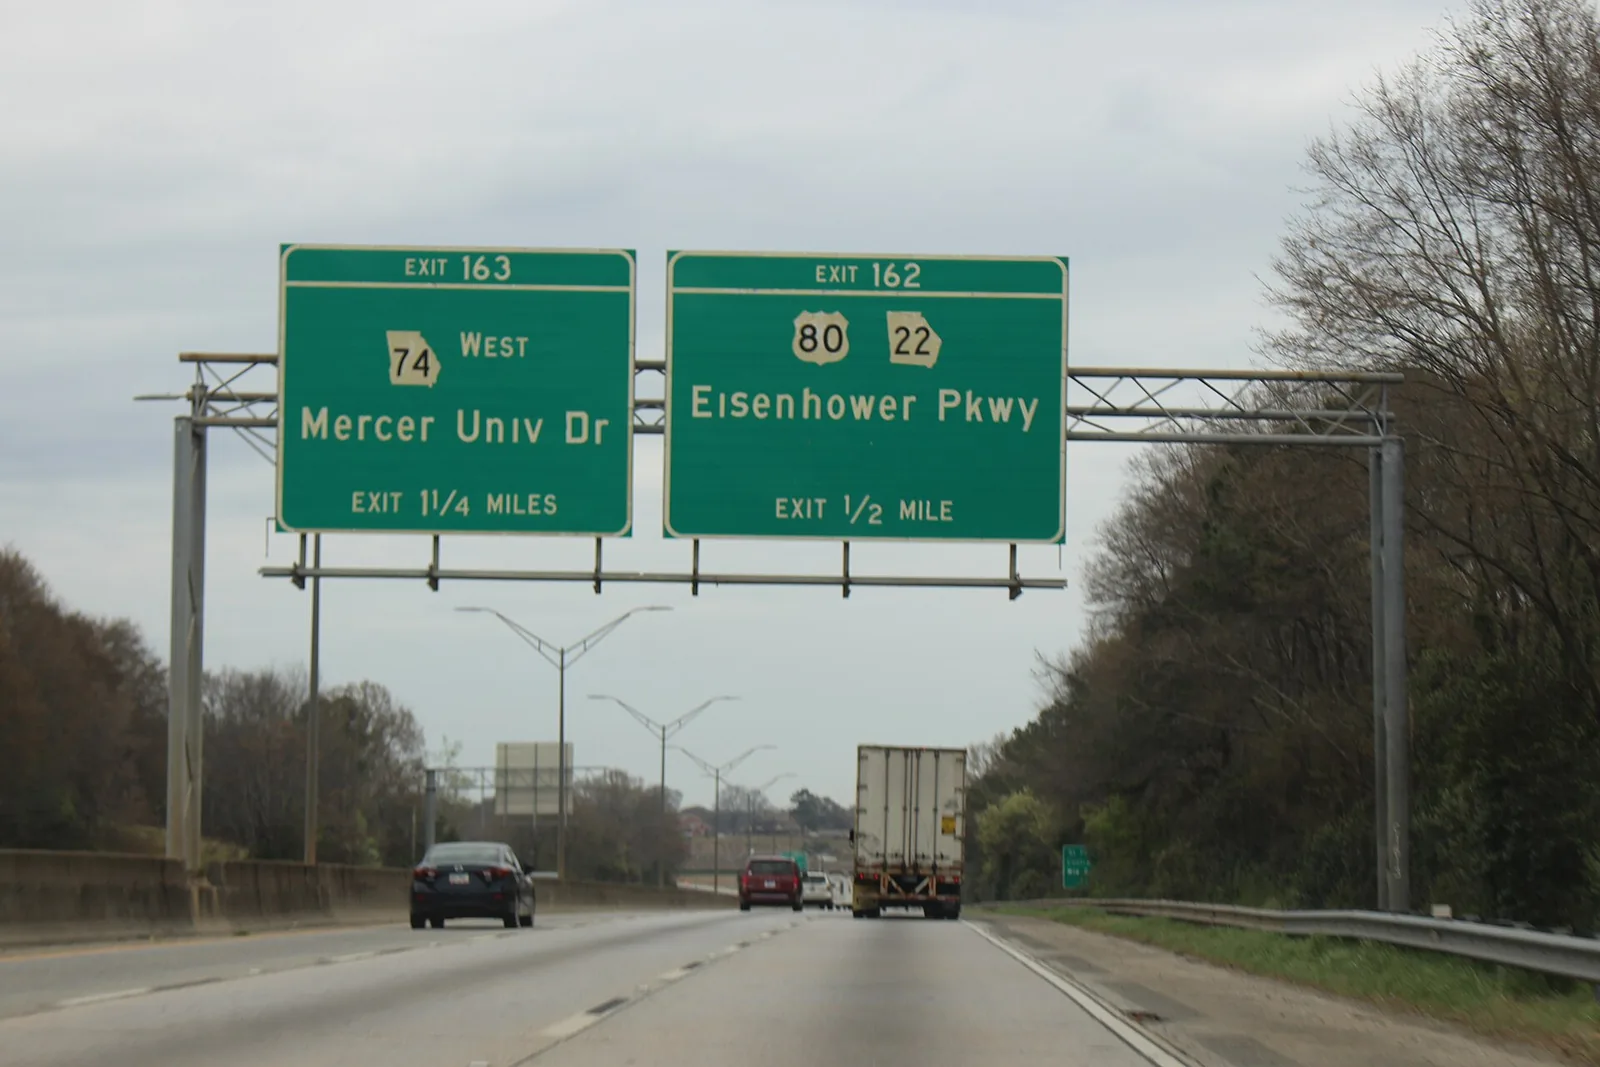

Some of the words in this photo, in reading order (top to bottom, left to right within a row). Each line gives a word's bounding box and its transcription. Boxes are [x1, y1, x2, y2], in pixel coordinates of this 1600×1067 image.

[406, 259, 447, 275] EXIT
[463, 256, 510, 280] 163
[816, 266, 857, 282] EXIT
[873, 263, 920, 287] 162
[799, 325, 843, 353] 80
[894, 327, 930, 355] 22
[394, 349, 430, 377] 74
[692, 386, 916, 420] Eisenhower
[939, 389, 1038, 431] Pkwy
[302, 407, 434, 441] Mercer
[458, 410, 542, 443] Univ
[566, 412, 608, 444] Dr
[353, 492, 401, 512] EXIT
[488, 494, 556, 514] MILES
[776, 498, 826, 518] EXIT
[900, 500, 952, 520] MILE
